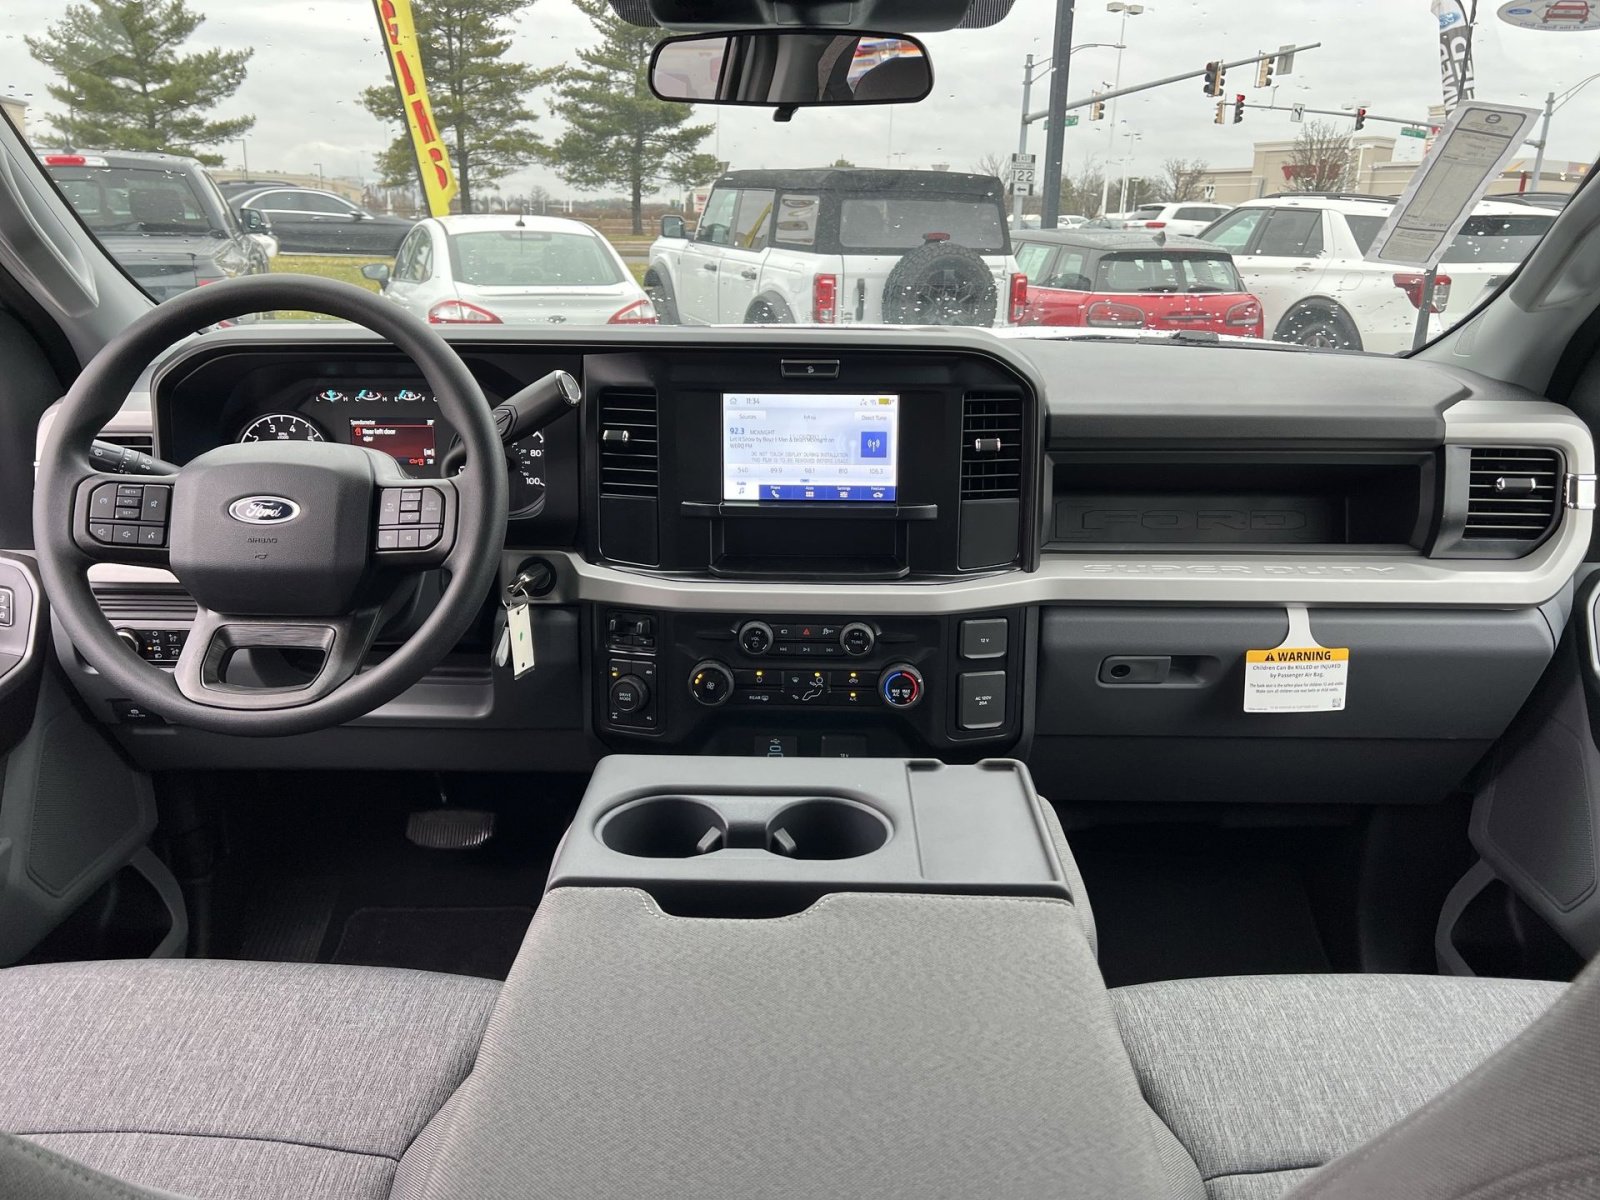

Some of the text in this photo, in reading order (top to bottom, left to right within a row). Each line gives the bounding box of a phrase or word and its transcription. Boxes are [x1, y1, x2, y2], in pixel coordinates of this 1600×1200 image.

[1012, 170, 1033, 182] 122
[269, 424, 276, 433] 3
[289, 424, 296, 433] 4
[1081, 509, 1308, 530] FORD
[1083, 564, 1396, 576] SUPER DUTY
[1278, 651, 1332, 662] WARNING
